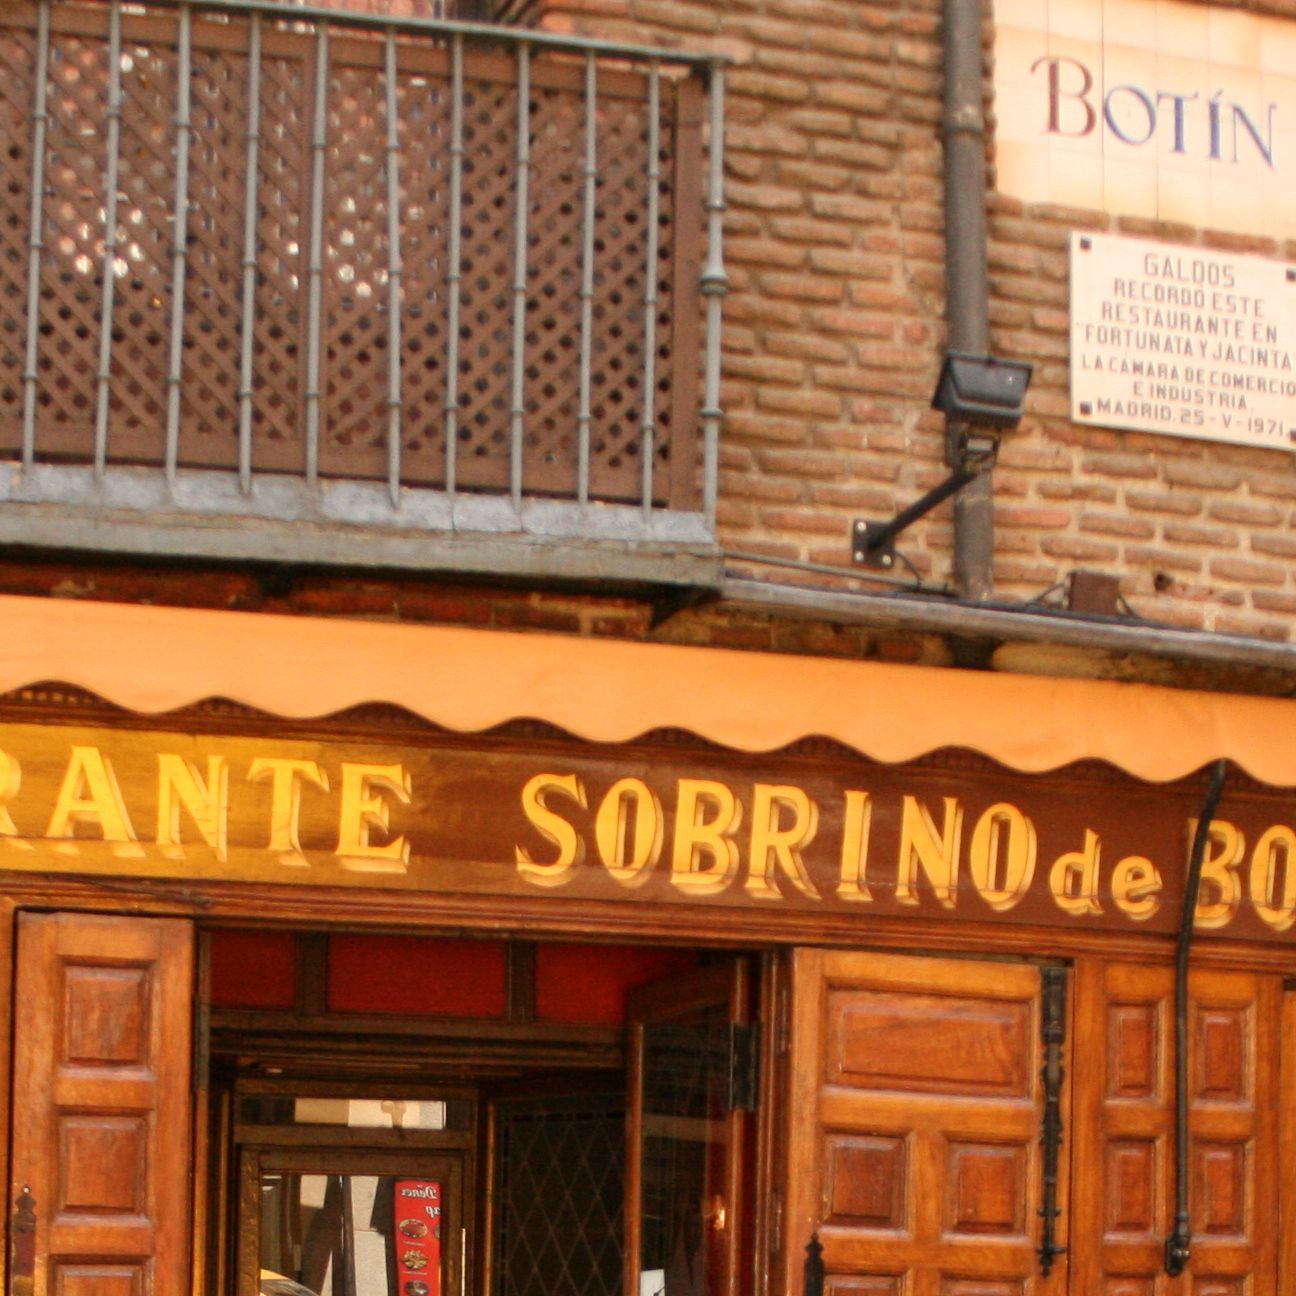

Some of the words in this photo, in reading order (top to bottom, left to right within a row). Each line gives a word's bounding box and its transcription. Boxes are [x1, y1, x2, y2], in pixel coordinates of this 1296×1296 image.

[1030, 56, 1278, 170] BOTÍN
[1212, 294, 1264, 318] ESTE
[1102, 301, 1244, 338] RESTAURANTE
[1252, 324, 1278, 344] EN
[1199, 340, 1208, 358] Y
[1082, 353, 1104, 371] LA
[1184, 366, 1205, 385] DE
[1133, 381, 1146, 397] E
[516, 772, 1039, 911] SOBRINO
[1048, 829, 1164, 922] de
